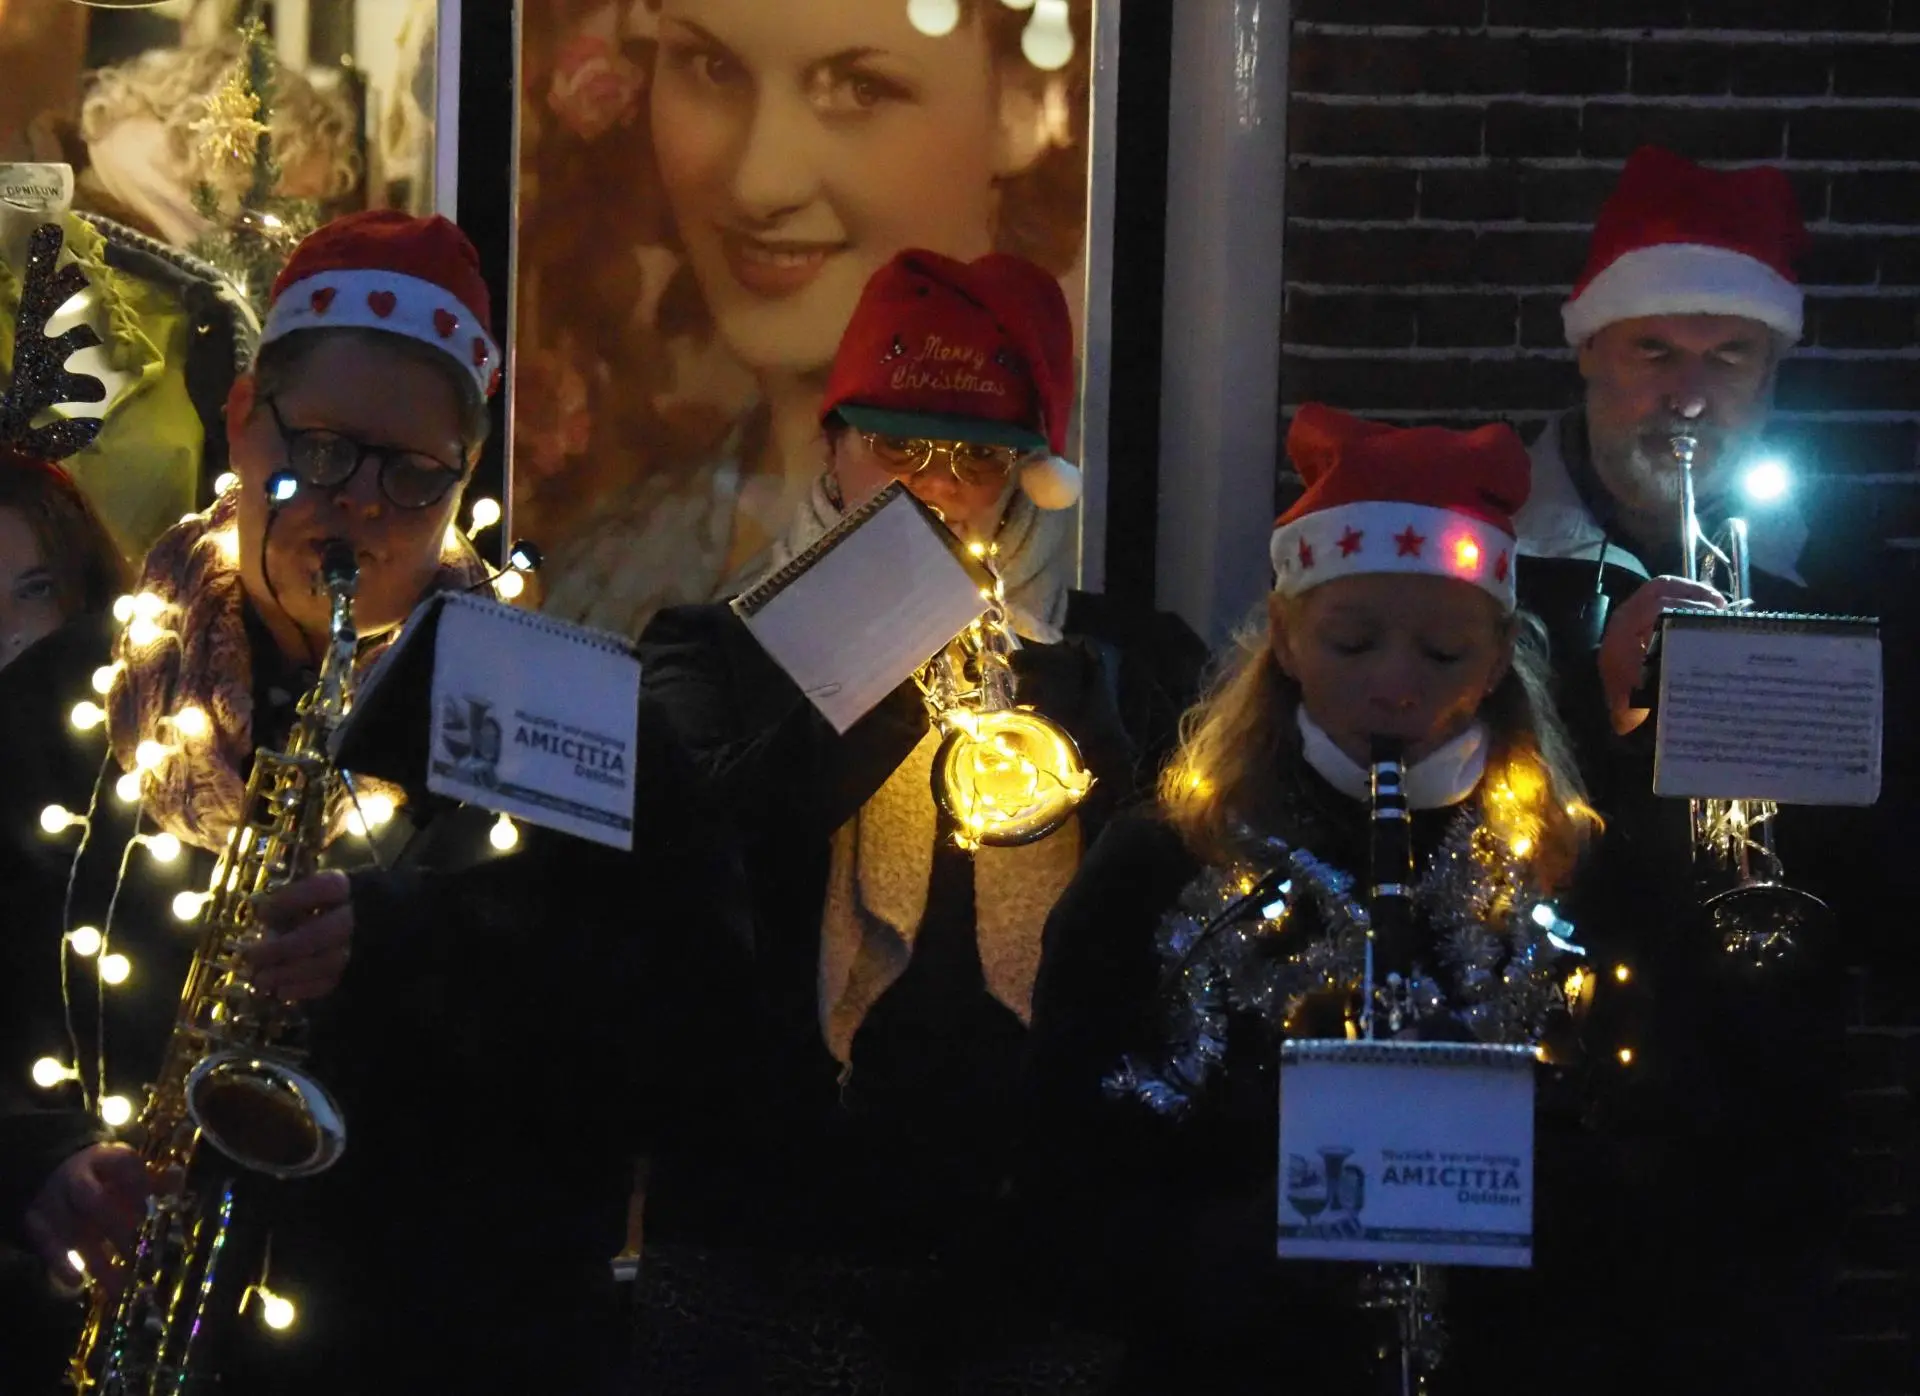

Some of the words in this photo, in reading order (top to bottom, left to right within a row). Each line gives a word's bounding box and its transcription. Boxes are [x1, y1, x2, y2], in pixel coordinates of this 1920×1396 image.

[912, 334, 984, 370] Merry
[891, 363, 1006, 396] Christmas
[514, 725, 624, 773] AMICITIA
[1382, 1165, 1520, 1189] AMICITIA
